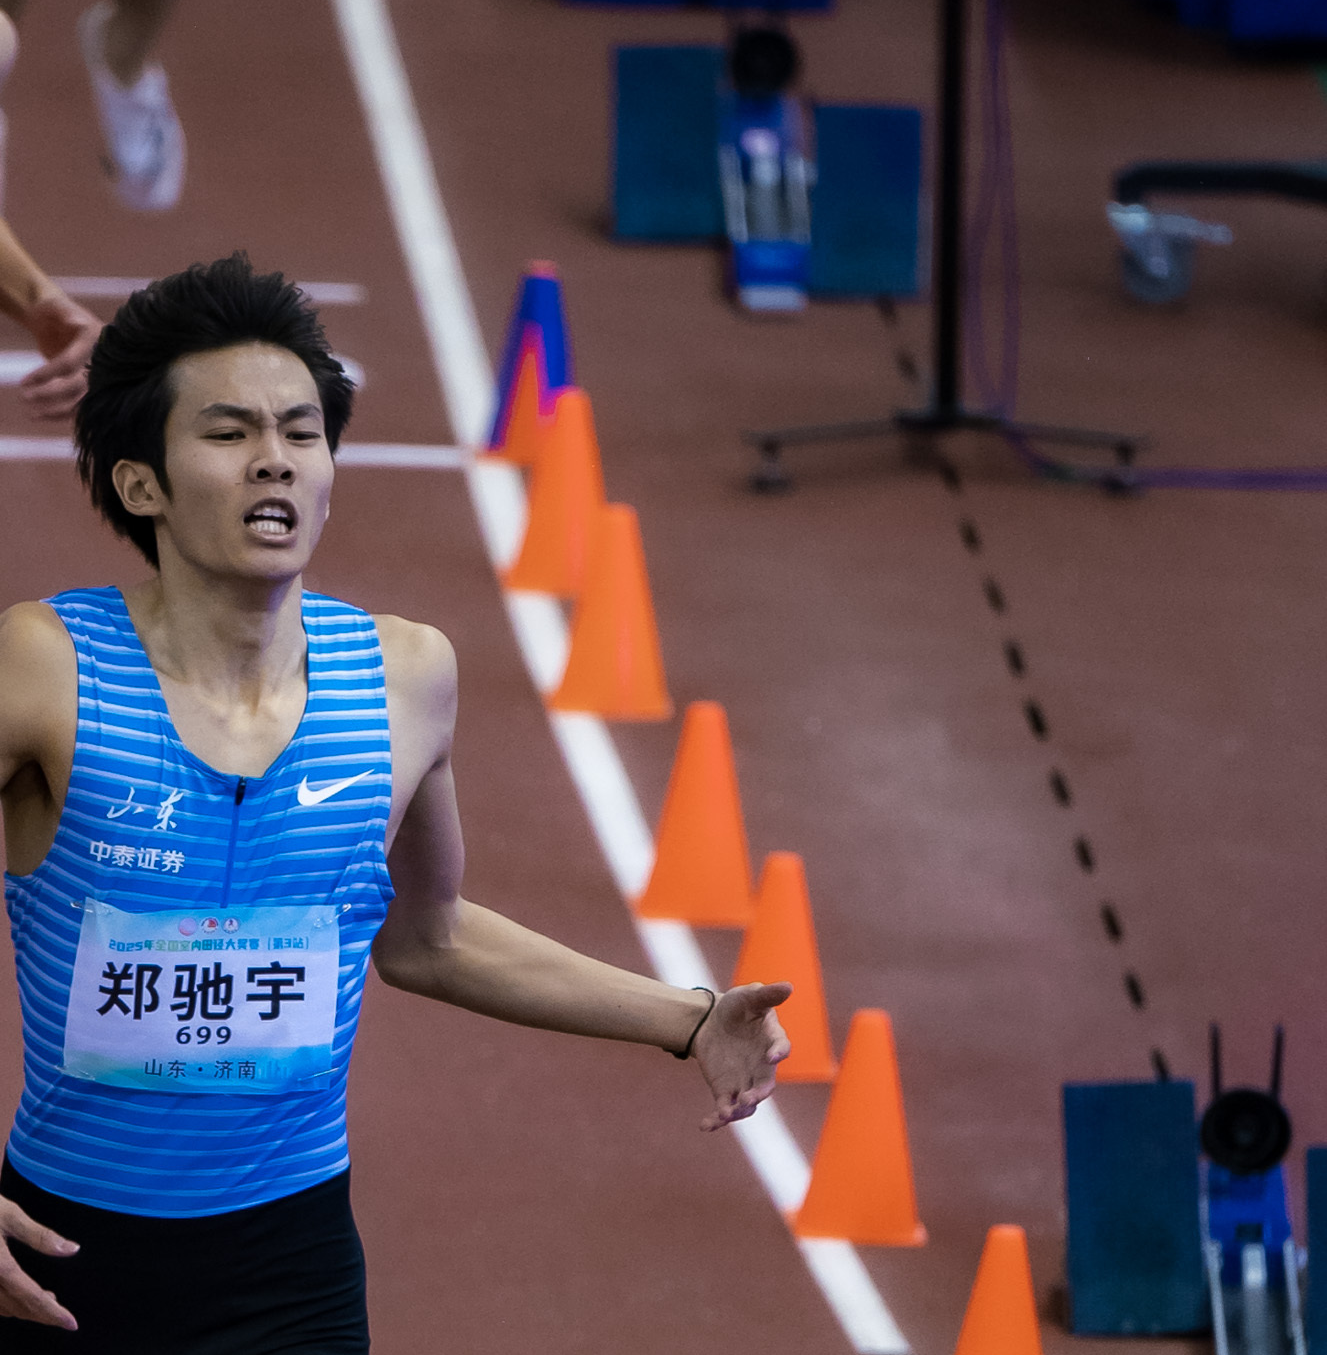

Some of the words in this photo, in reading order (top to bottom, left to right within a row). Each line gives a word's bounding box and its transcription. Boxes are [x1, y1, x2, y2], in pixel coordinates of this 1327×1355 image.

[89, 840, 185, 873] 中泰证券
[97, 961, 305, 1020] 郑驰宇
[175, 1026, 232, 1045] 699
